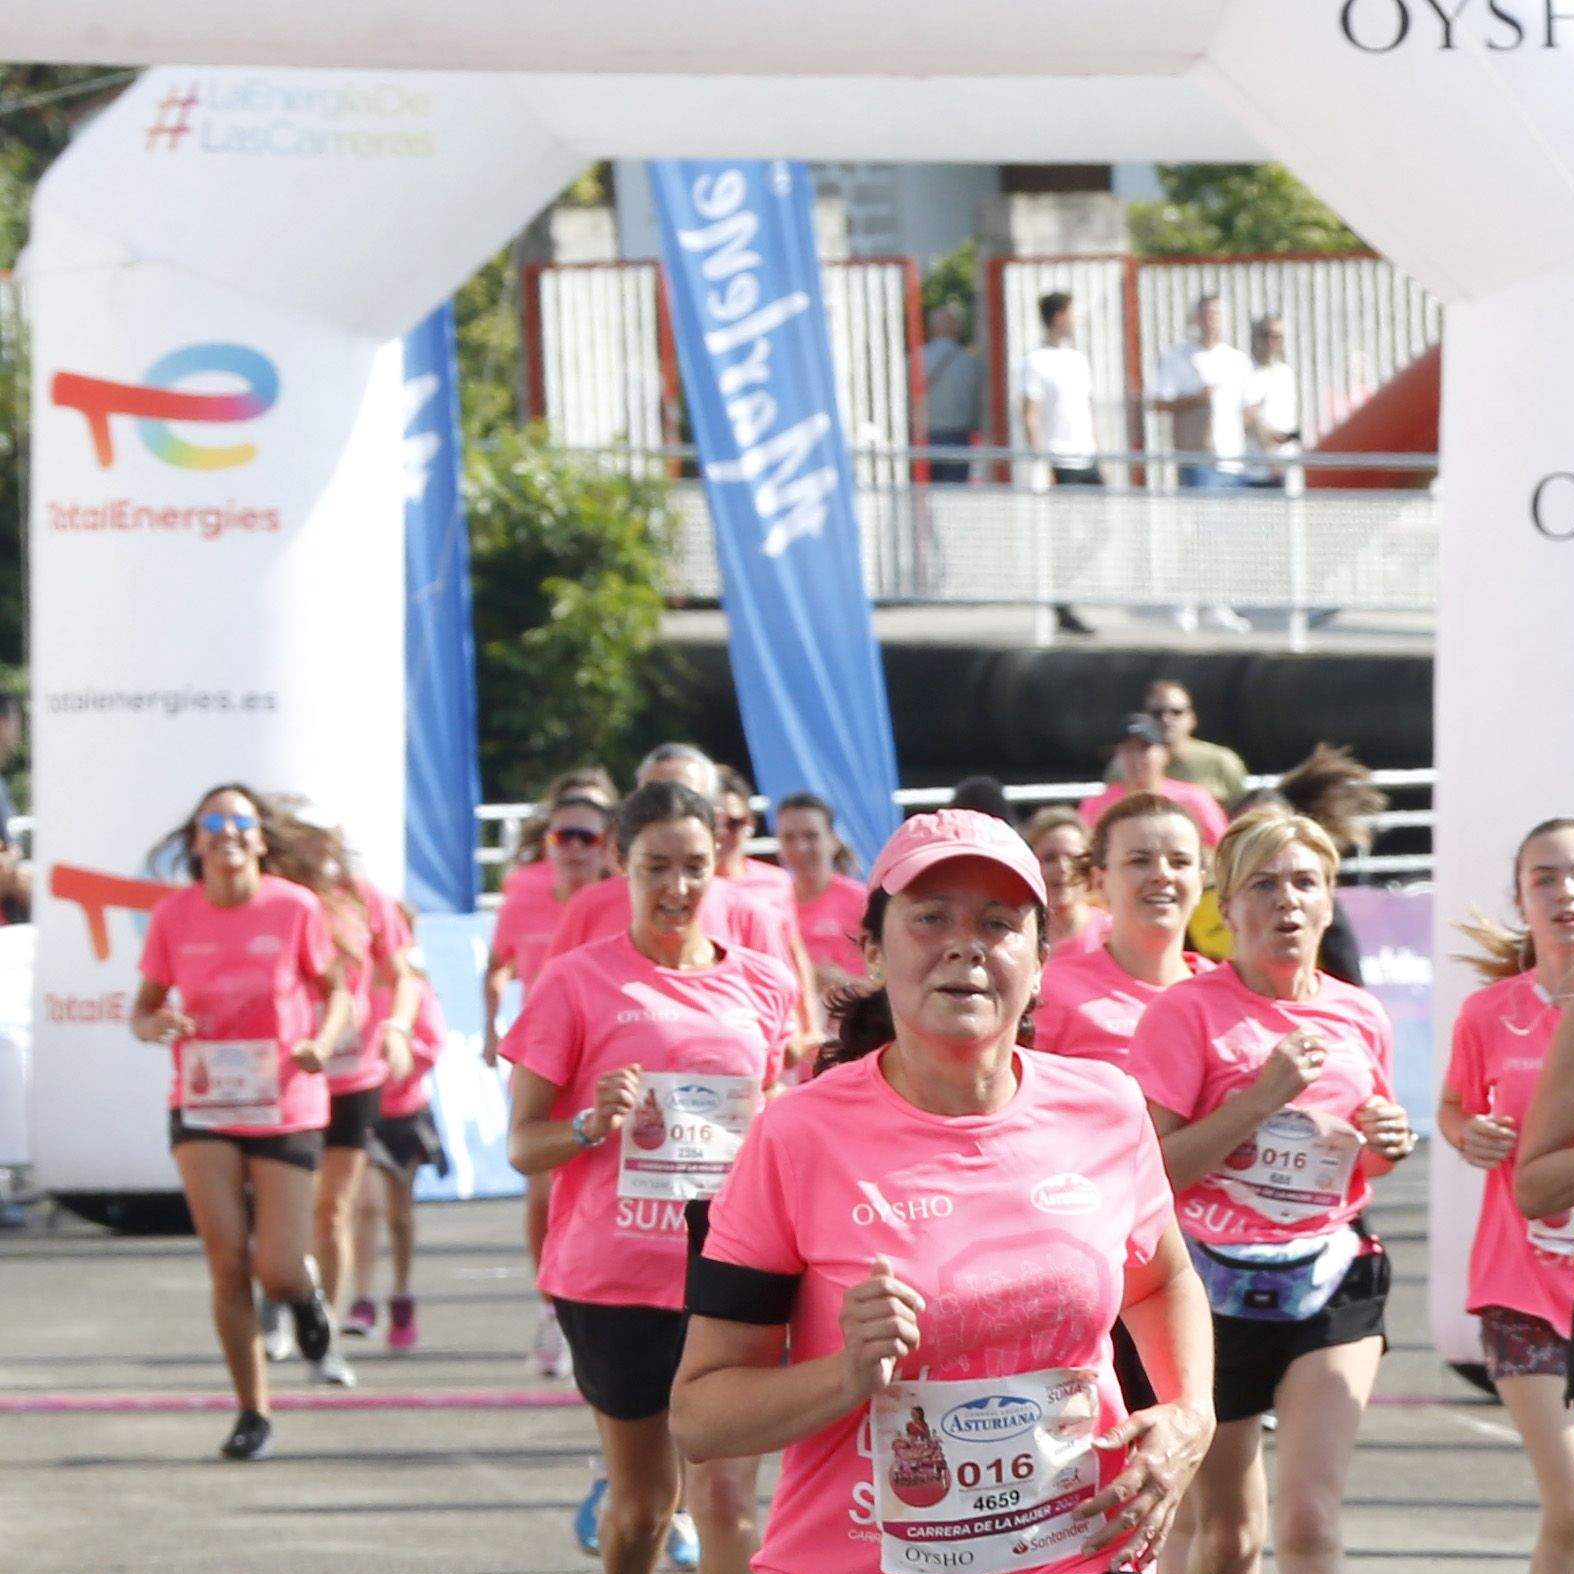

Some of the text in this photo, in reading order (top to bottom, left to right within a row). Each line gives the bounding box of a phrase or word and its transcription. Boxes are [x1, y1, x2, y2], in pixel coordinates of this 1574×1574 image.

[669, 1123, 713, 1143] 016
[1262, 1147, 1308, 1170] 016
[615, 1199, 688, 1231] SUM
[949, 1409, 1037, 1434] ASTURIANA
[956, 1453, 1035, 1489] 016
[973, 1490, 1021, 1512] 4659
[906, 1522, 971, 1539] CARRERA
[973, 1519, 993, 1535] DE
[995, 1516, 1013, 1531] LA
[1030, 1521, 1092, 1552] Santander
[905, 1546, 975, 1568] OYSHO
